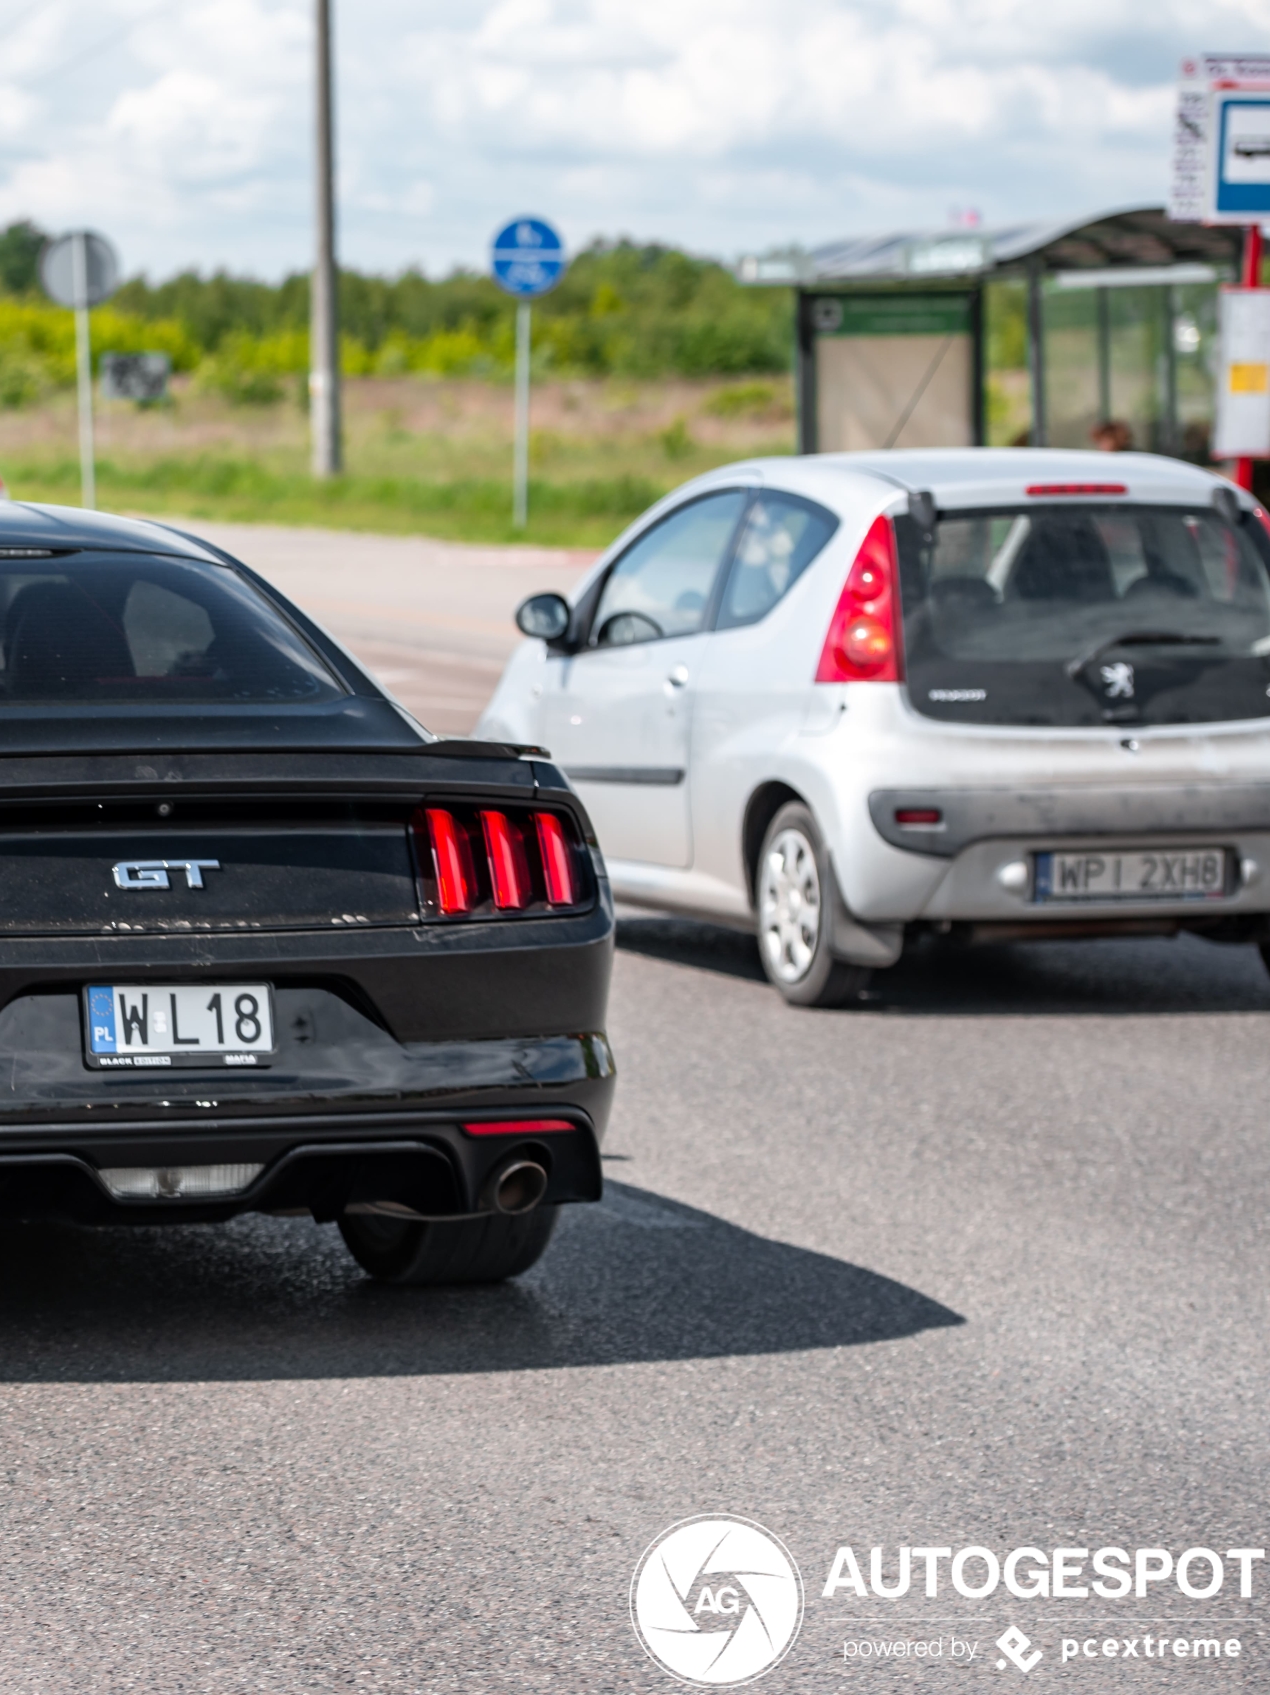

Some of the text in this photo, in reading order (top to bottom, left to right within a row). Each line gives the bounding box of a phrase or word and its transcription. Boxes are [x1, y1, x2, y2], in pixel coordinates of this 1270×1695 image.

[112, 859, 220, 889] GT
[94, 1027, 113, 1042] PL
[99, 1057, 132, 1066] BLACK
